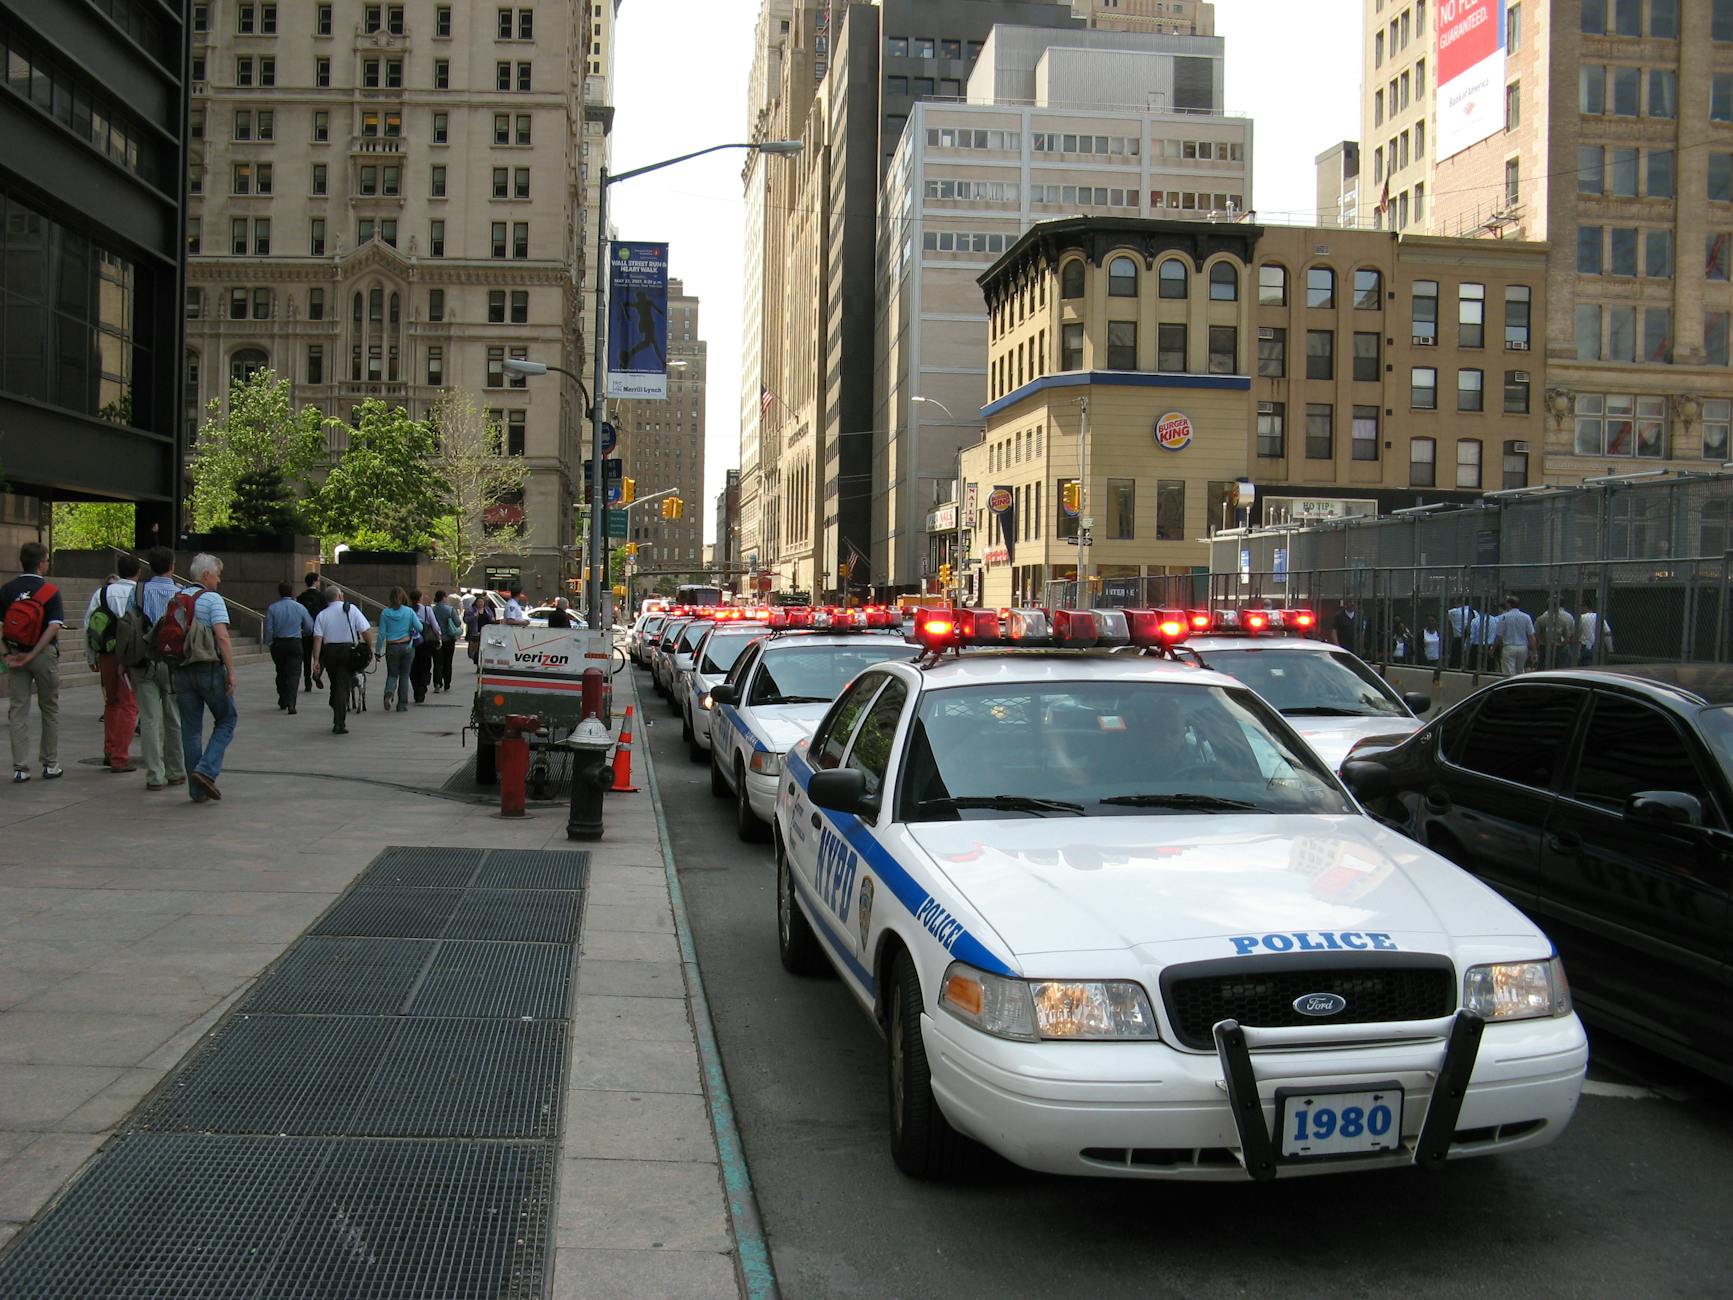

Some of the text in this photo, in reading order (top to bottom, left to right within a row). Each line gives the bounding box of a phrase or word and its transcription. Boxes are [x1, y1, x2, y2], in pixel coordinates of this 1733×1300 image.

[1440, 0, 1455, 28] NO
[1440, 6, 1488, 49] GUARANTEED.
[1158, 419, 1189, 433] BURGER
[1160, 426, 1190, 442] KING
[991, 498, 1010, 507] KING
[514, 651, 569, 667] verizon
[815, 826, 858, 924] NYPD
[917, 897, 964, 951] POLICE
[1229, 932, 1399, 955] POLICE
[1306, 997, 1334, 1011] Ford
[1294, 1104, 1392, 1141] 1980
